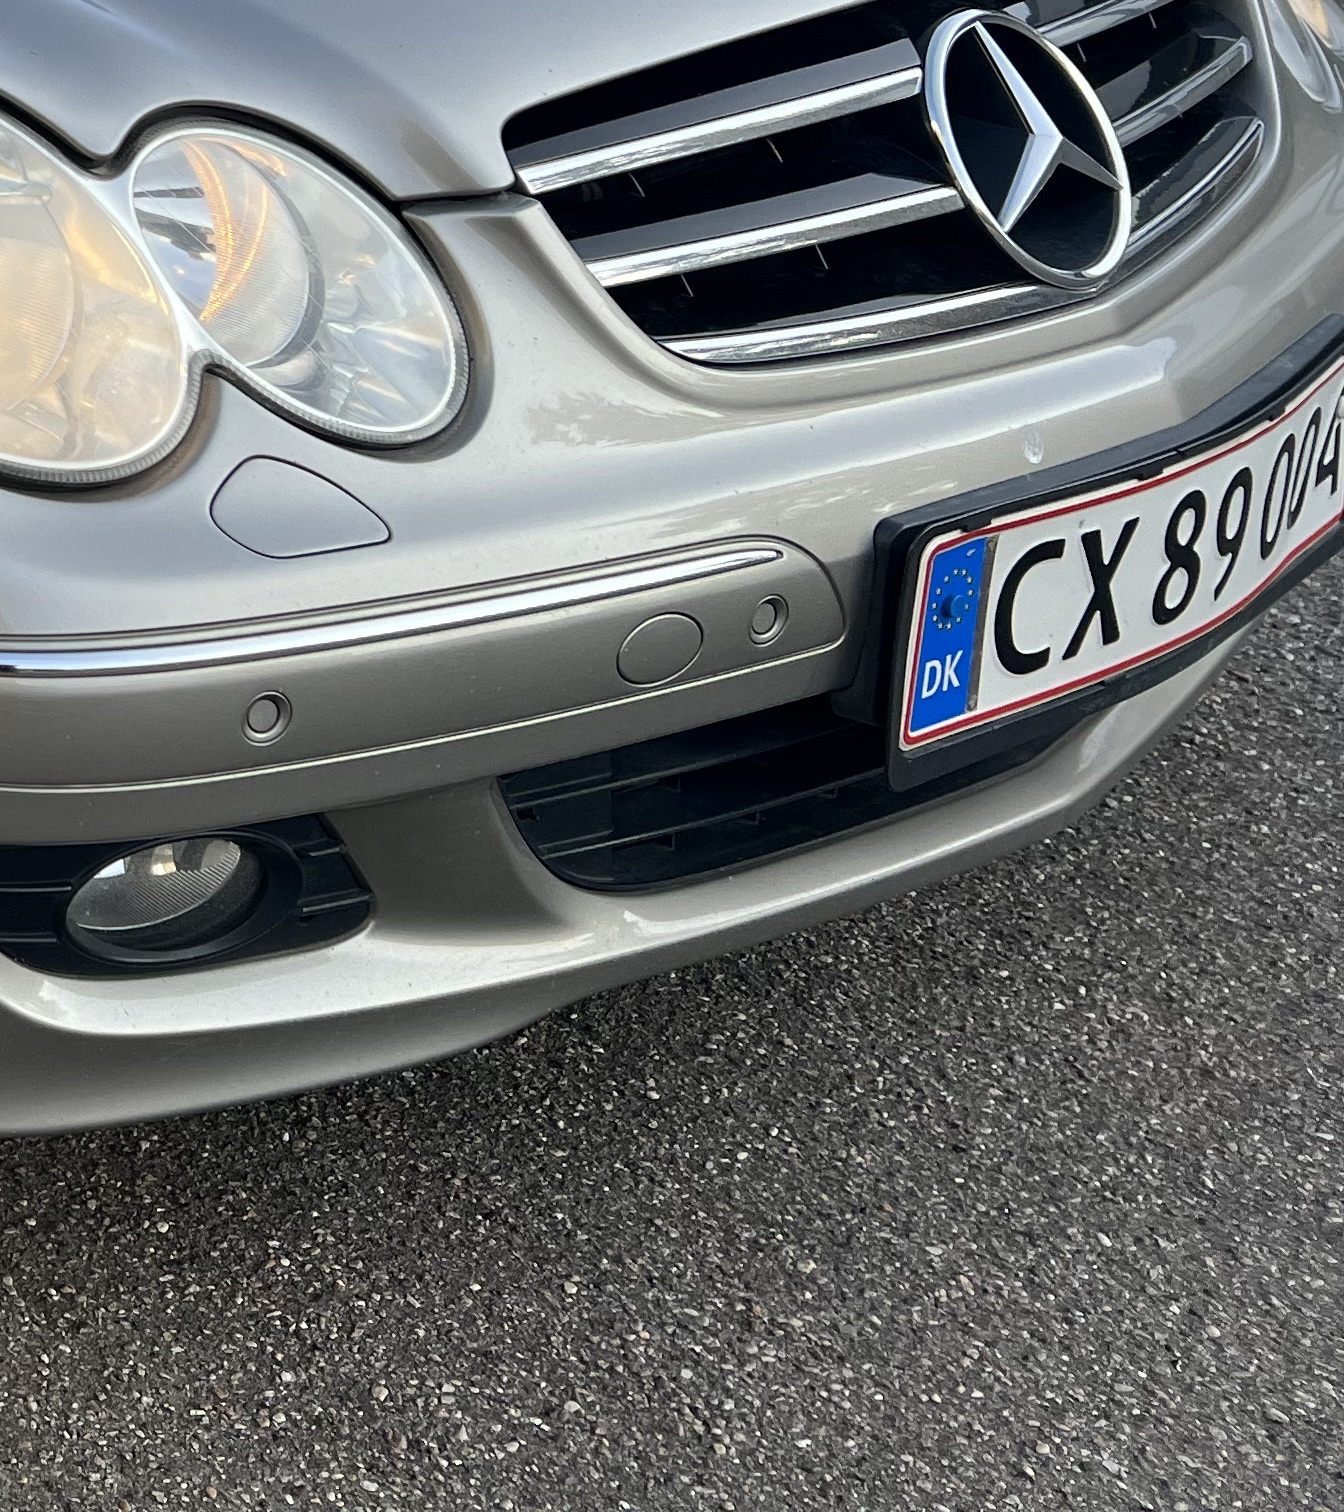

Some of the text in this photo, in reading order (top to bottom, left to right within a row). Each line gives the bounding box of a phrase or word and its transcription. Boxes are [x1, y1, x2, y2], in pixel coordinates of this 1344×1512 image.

[994, 516, 1140, 675] CX
[1152, 466, 1254, 626] 89
[921, 649, 964, 699] DK
